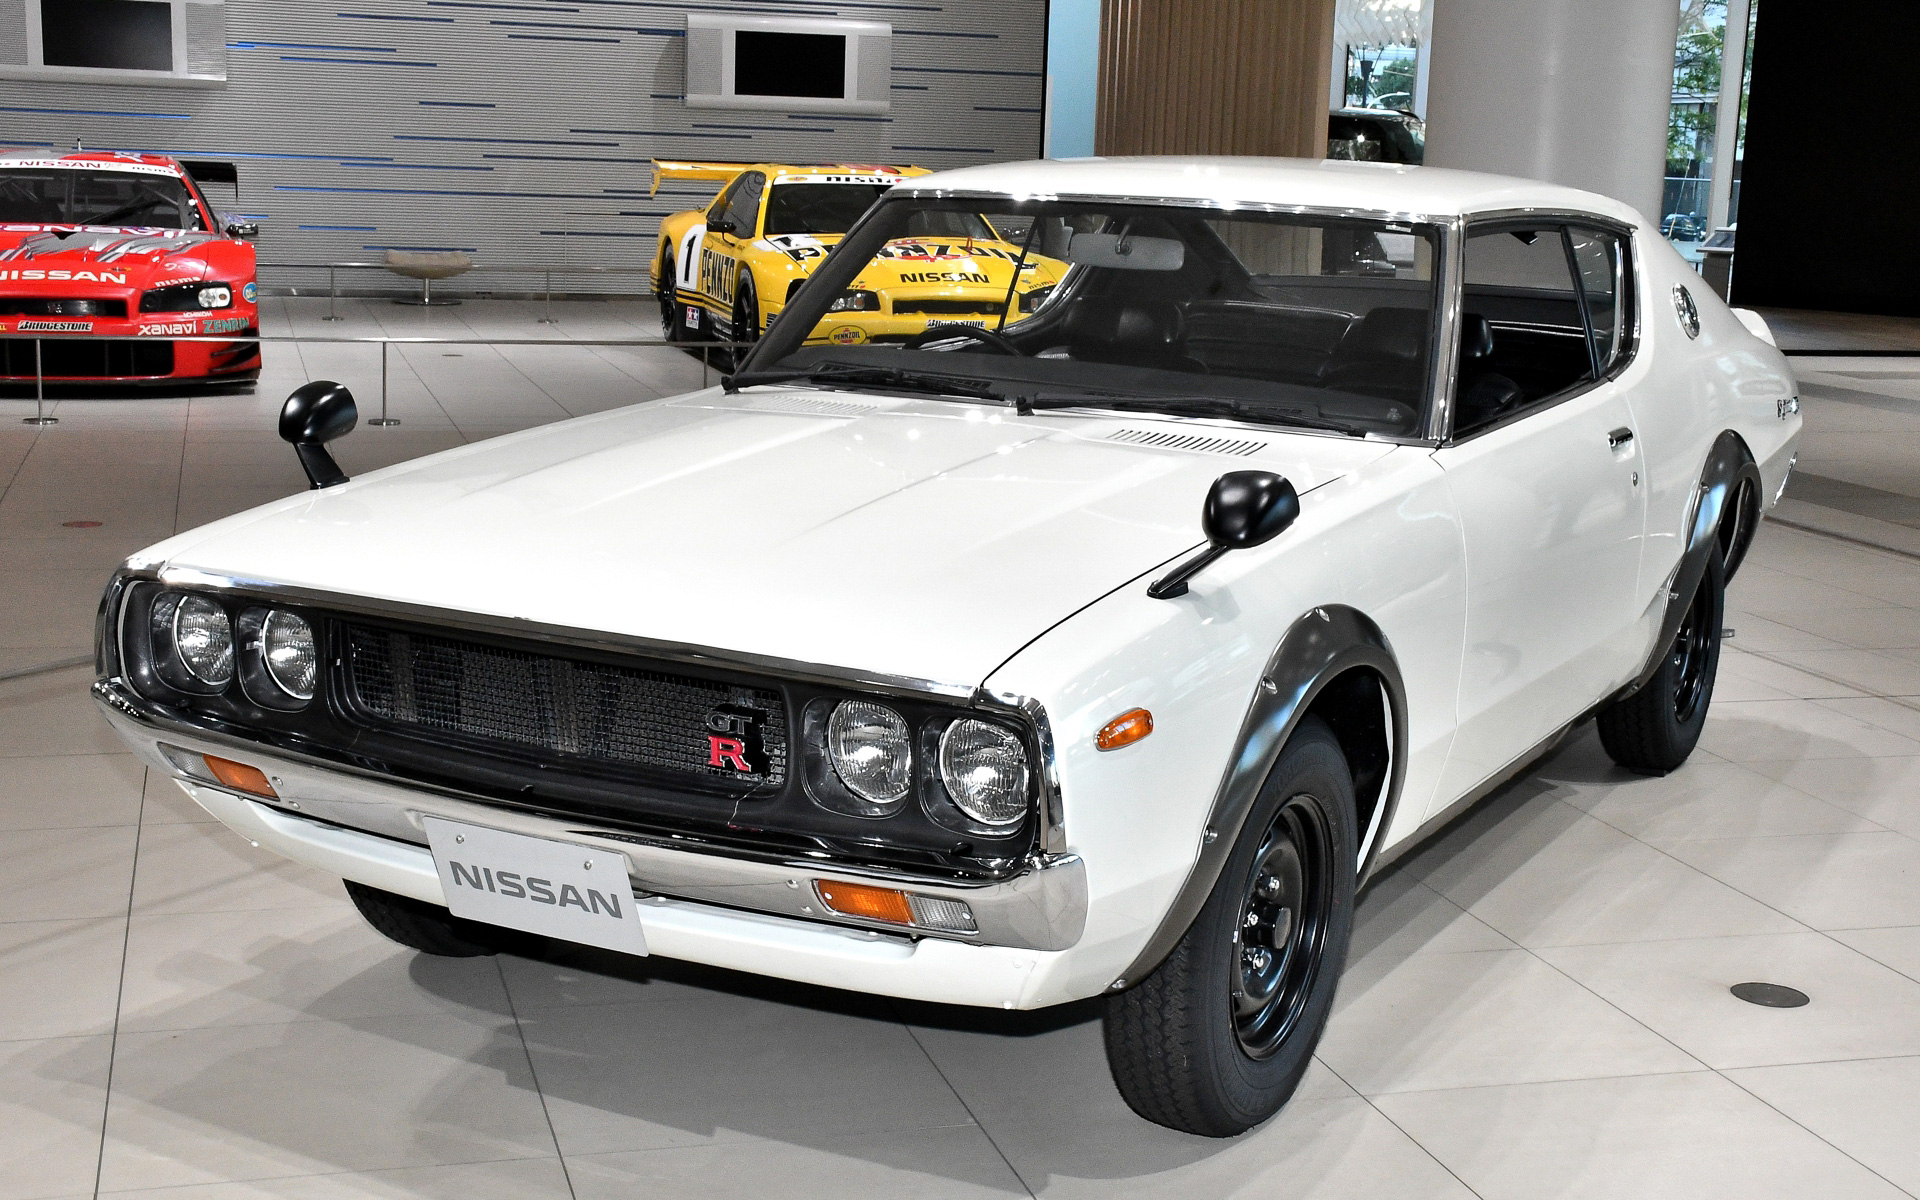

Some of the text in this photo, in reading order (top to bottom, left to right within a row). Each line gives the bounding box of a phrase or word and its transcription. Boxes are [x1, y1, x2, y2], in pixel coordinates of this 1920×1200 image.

[19, 159, 101, 169] NISSAN
[683, 234, 698, 283] 1
[155, 276, 201, 288] nismo
[900, 272, 990, 284] NISSAN
[18, 321, 93, 331] BRIDGESTONE
[833, 331, 861, 341] PENNZOIL
[705, 710, 753, 735] GT
[708, 736, 752, 772] R
[449, 860, 623, 920] NISSAN
